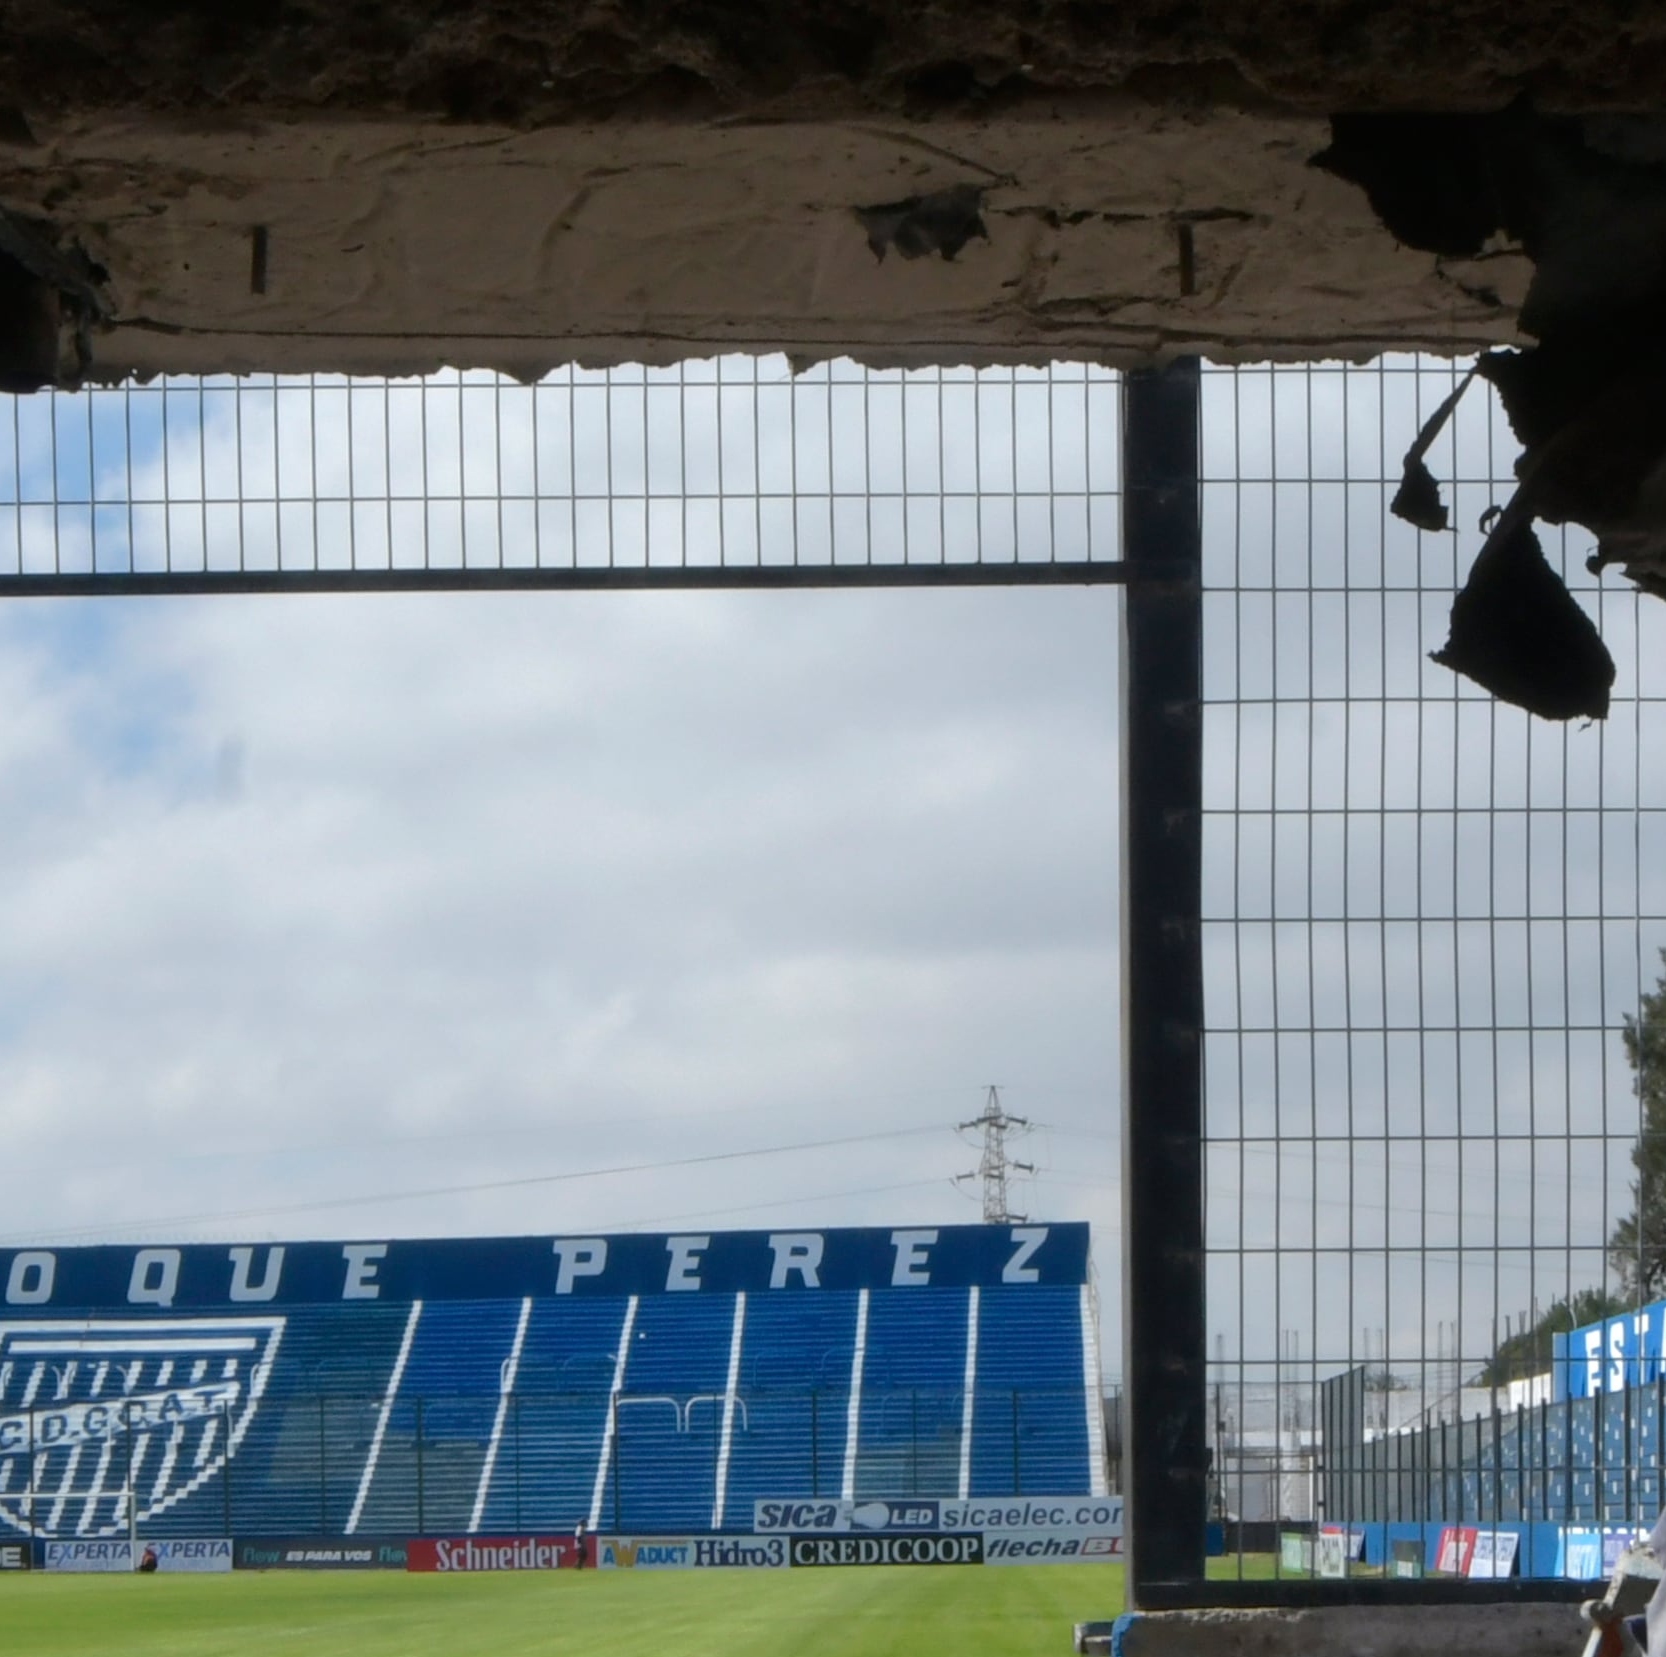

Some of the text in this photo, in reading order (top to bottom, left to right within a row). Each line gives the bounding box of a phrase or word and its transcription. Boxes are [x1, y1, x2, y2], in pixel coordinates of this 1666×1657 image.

[552, 1227, 1050, 1295] PEREZ
[890, 1508, 934, 1525] LED
[47, 1542, 132, 1565] EXPERTA
[305, 1549, 341, 1562] PARA
[343, 1549, 373, 1562] VOS
[436, 1539, 566, 1571] Schneider
[602, 1539, 785, 1568] AWADUCT Hidro3
[794, 1537, 979, 1565] CREDICOOP
[986, 1537, 1082, 1558] flecha
